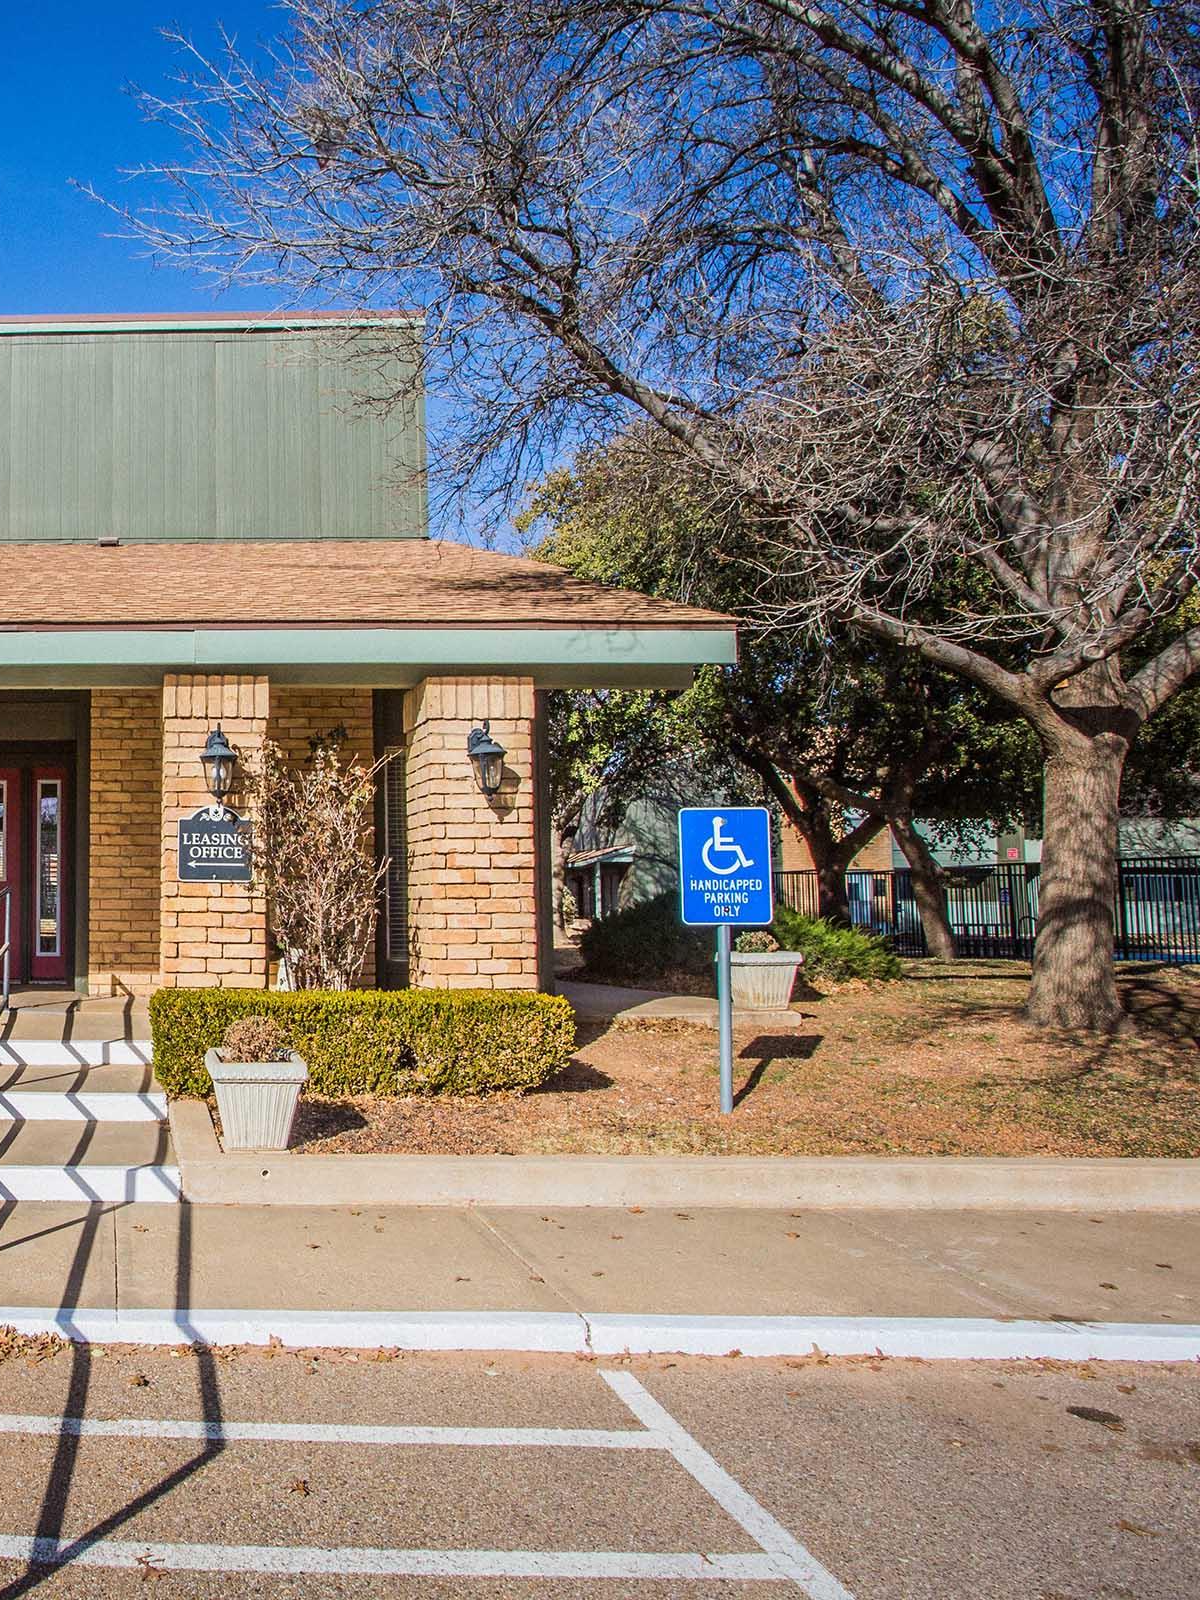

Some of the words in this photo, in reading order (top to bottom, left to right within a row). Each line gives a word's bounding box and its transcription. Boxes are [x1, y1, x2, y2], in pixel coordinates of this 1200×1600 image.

[182, 833, 249, 846] LEASING
[189, 846, 244, 859] OFFICE
[690, 879, 763, 891] HANDICAPPED
[704, 892, 749, 904] PARKING
[713, 905, 740, 917] ONLY
